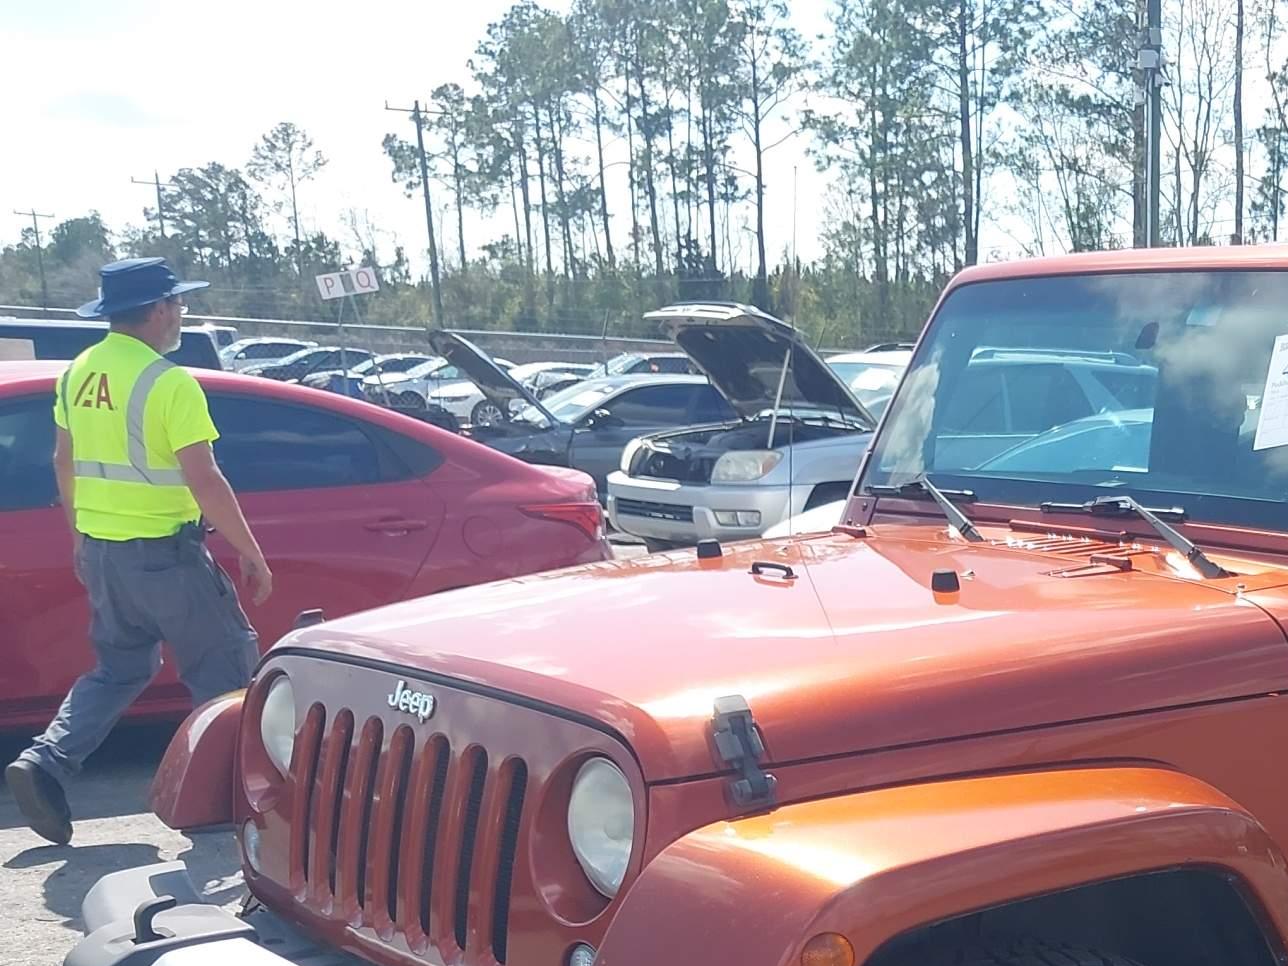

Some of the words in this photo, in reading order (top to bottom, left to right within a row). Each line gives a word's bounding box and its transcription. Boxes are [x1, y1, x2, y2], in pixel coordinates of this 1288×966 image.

[323, 277, 335, 296] P
[356, 270, 376, 289] Q
[387, 680, 434, 724] Jeep
